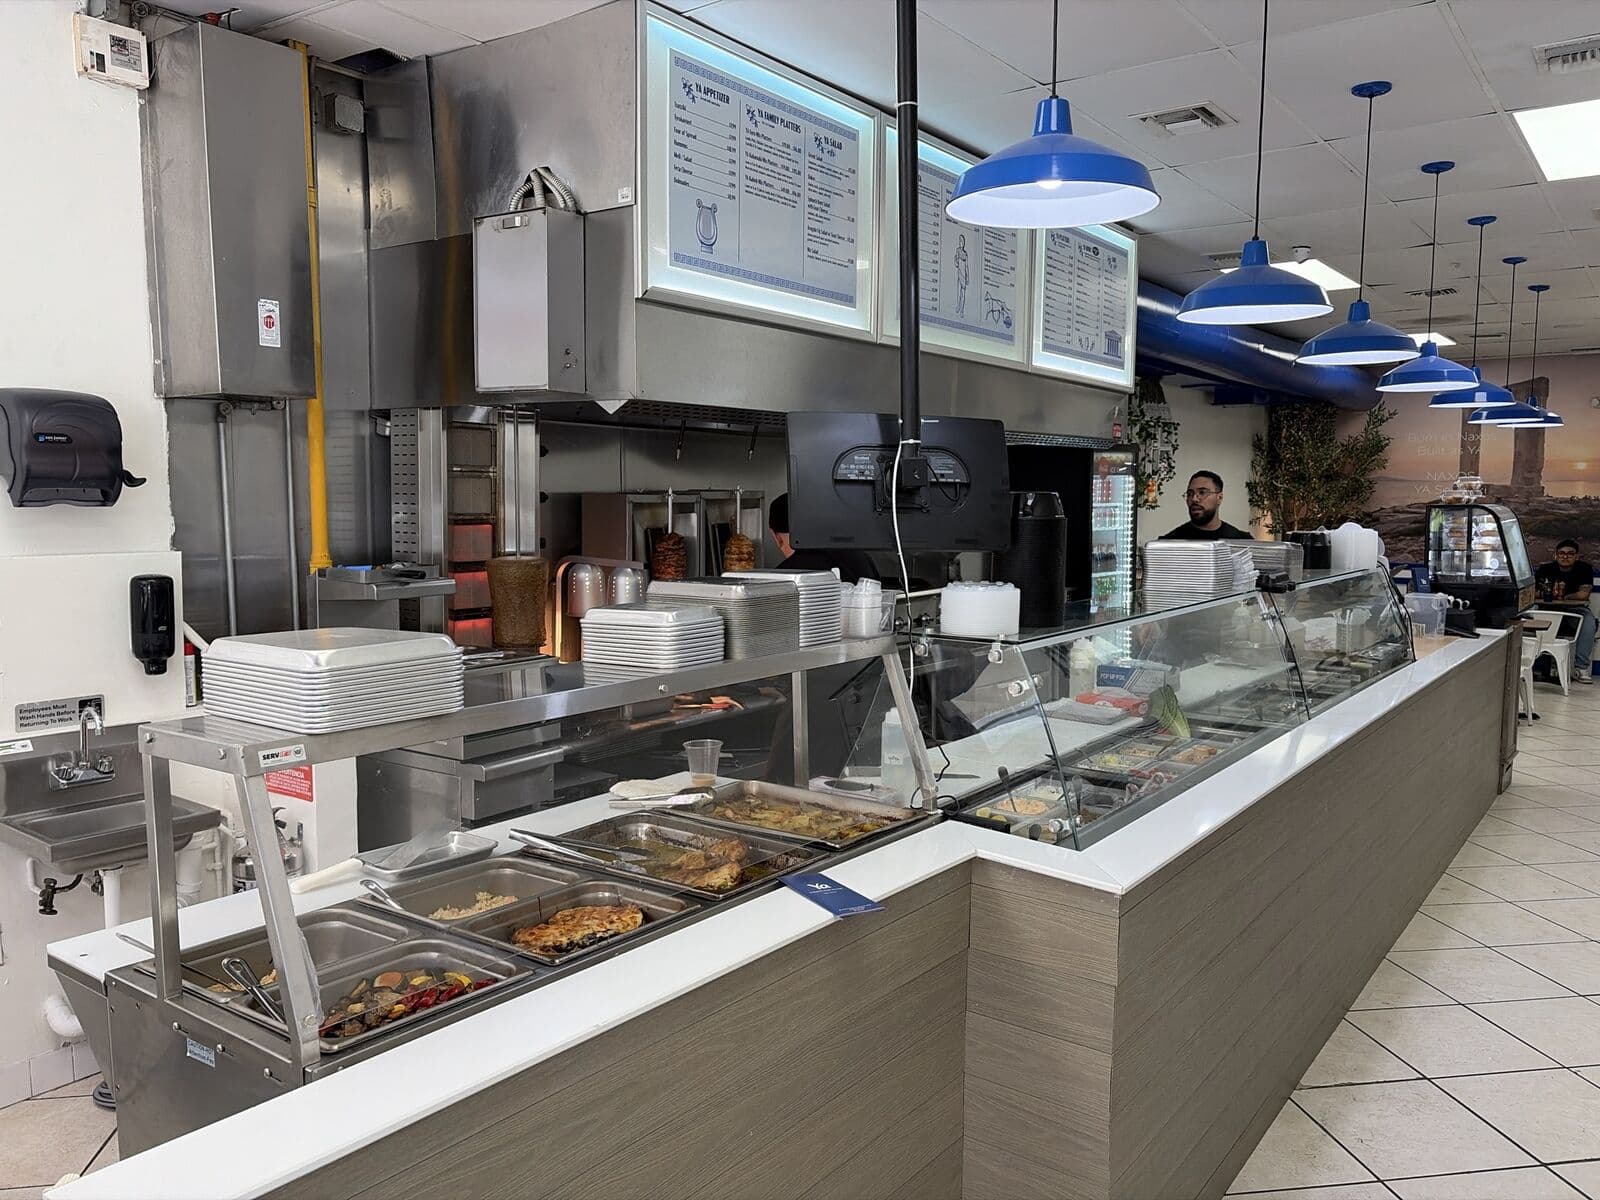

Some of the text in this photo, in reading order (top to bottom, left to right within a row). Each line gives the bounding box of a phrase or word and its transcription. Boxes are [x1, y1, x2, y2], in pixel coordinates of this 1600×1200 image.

[695, 82, 702, 93] YA
[703, 86, 730, 105] APPETIZER
[757, 108, 764, 118] YA
[764, 110, 780, 126] FAMILY
[779, 116, 802, 134] PLATTERS
[824, 135, 843, 151] YA SALAD
[19, 705, 52, 715] Employees
[19, 709, 76, 721] Wash Hands Before
[19, 719, 49, 728] Returning
